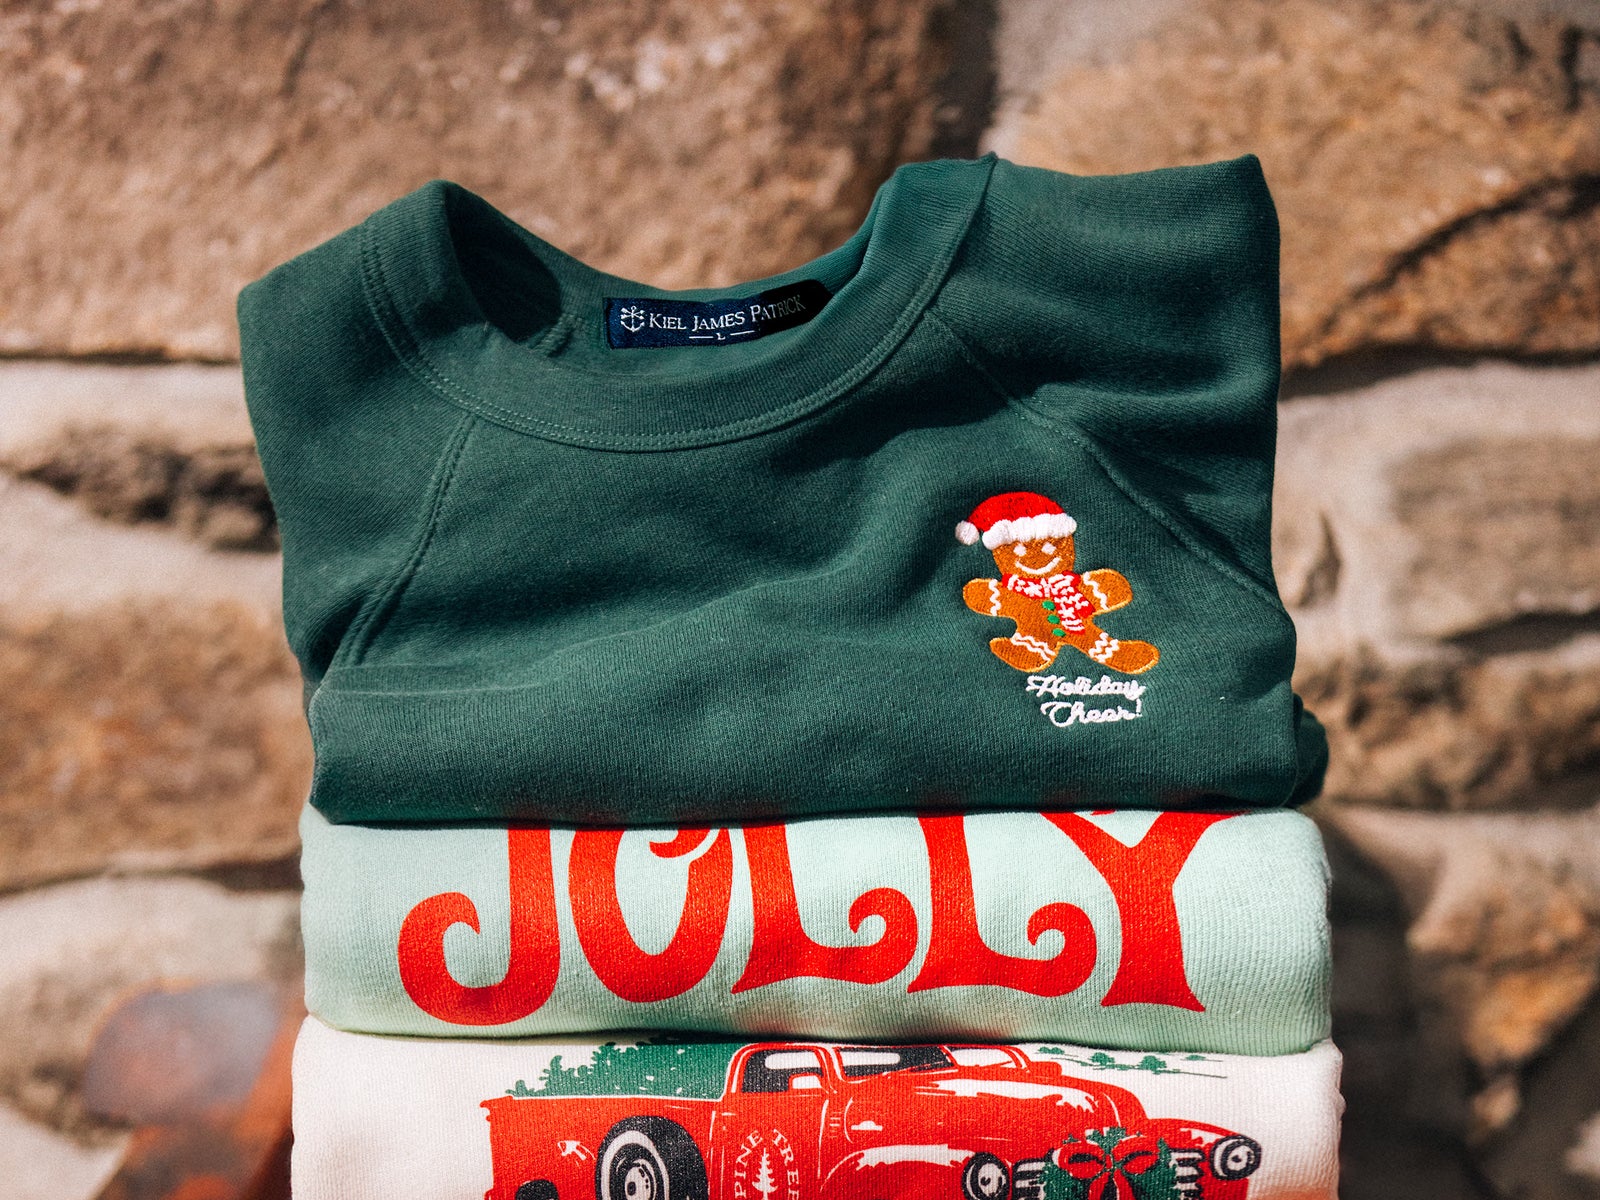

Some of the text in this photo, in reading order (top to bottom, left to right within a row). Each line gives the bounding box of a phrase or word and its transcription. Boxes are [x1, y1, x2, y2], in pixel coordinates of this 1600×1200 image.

[1025, 674, 1146, 701] Holiday
[398, 810, 1246, 1026] JOLLY
[733, 1130, 764, 1199] PINE
